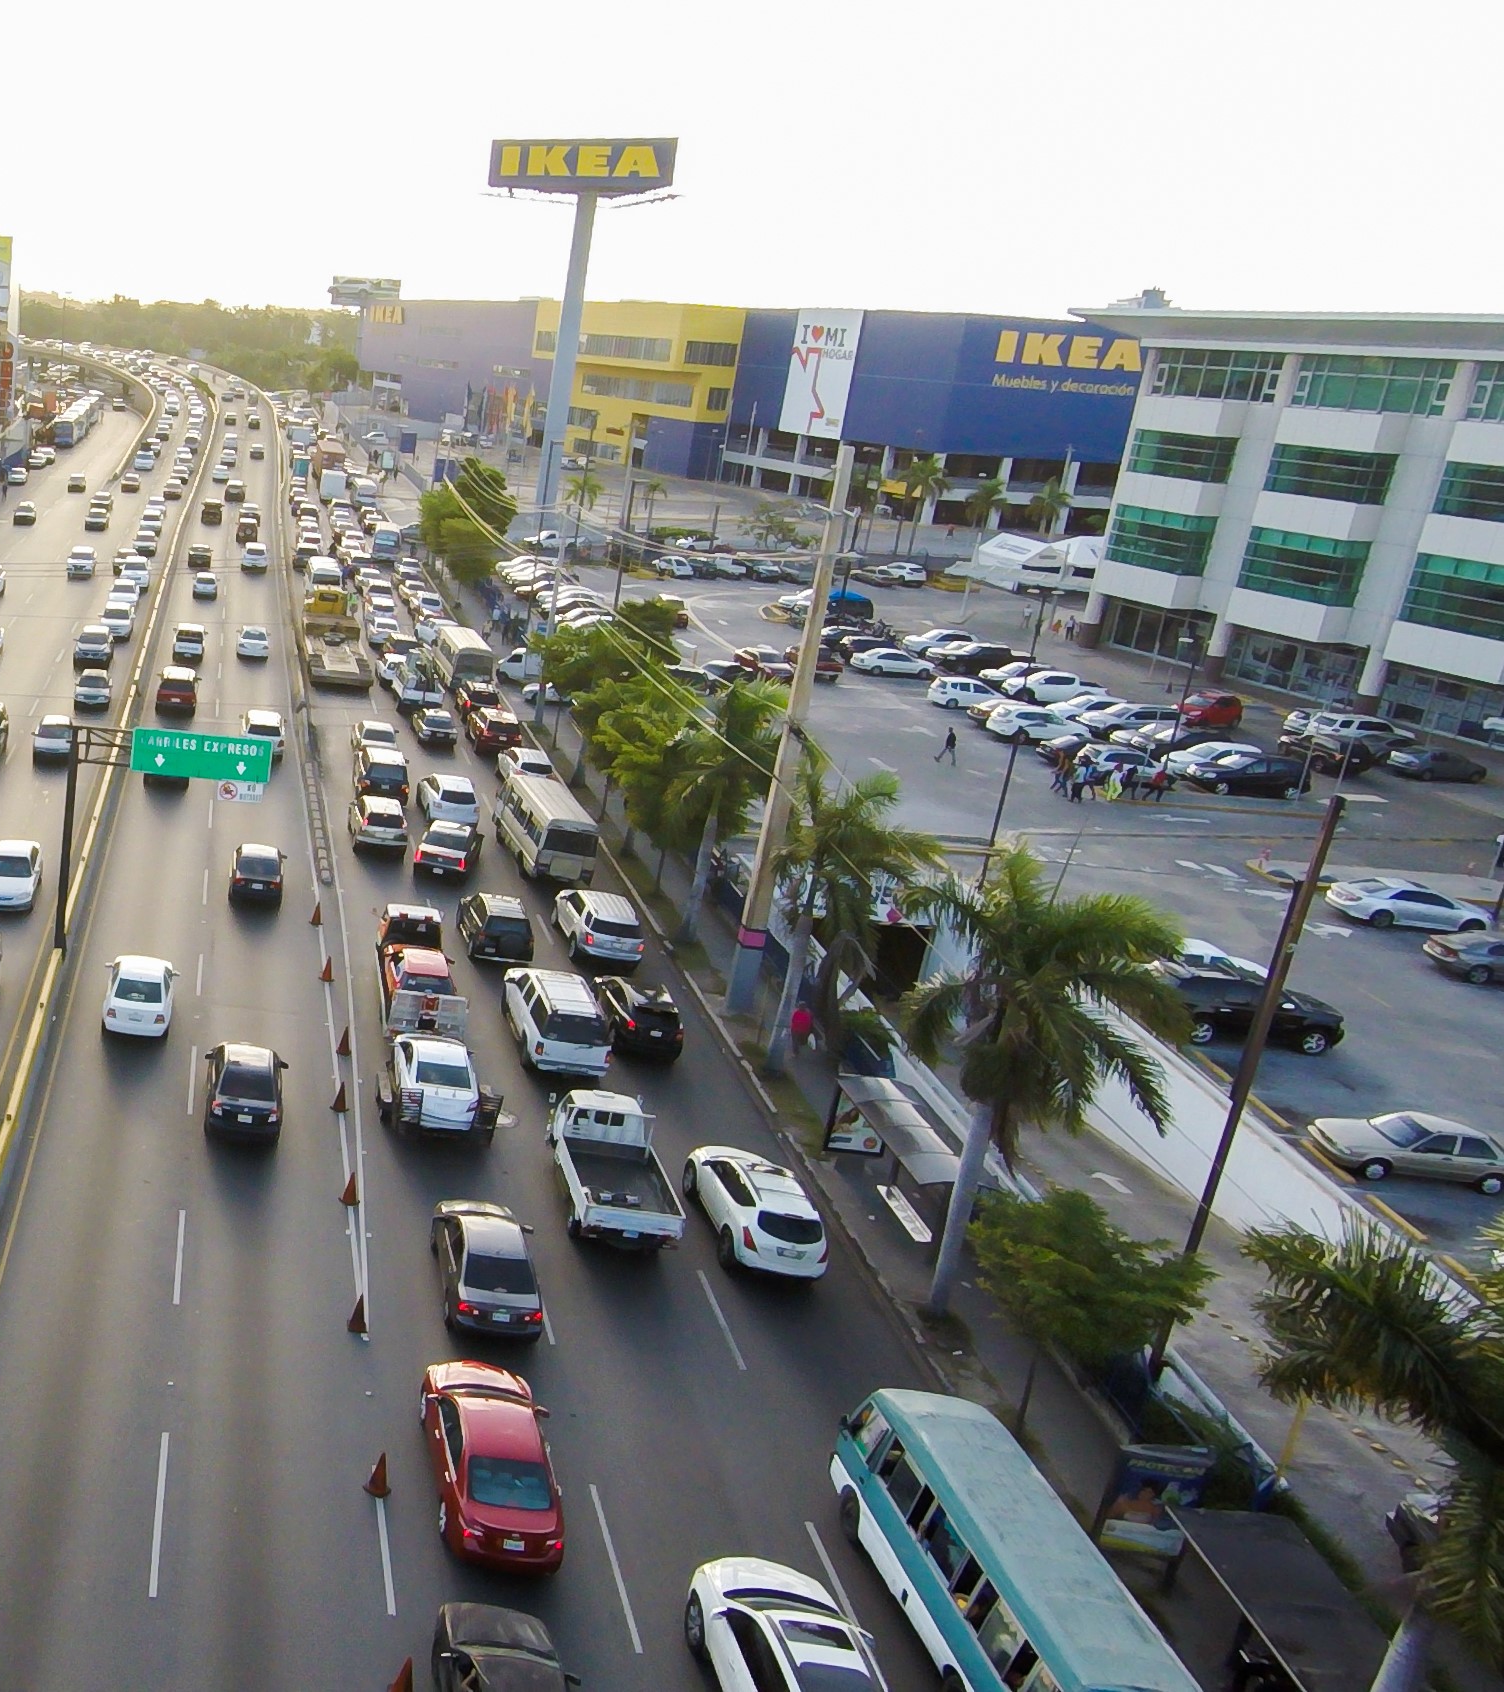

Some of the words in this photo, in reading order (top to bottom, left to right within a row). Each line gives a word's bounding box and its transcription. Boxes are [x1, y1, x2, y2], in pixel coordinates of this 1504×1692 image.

[500, 145, 661, 177] IKEA
[370, 304, 404, 325] IKEA
[824, 327, 847, 347] MI
[822, 348, 854, 360] HOGAR
[995, 330, 1142, 371] IKEA
[992, 373, 1047, 390] Muebles
[1050, 379, 1059, 394] y
[1061, 378, 1136, 396] decoración
[141, 735, 197, 751] ARRILES
[203, 740, 265, 757] EXPRESOS
